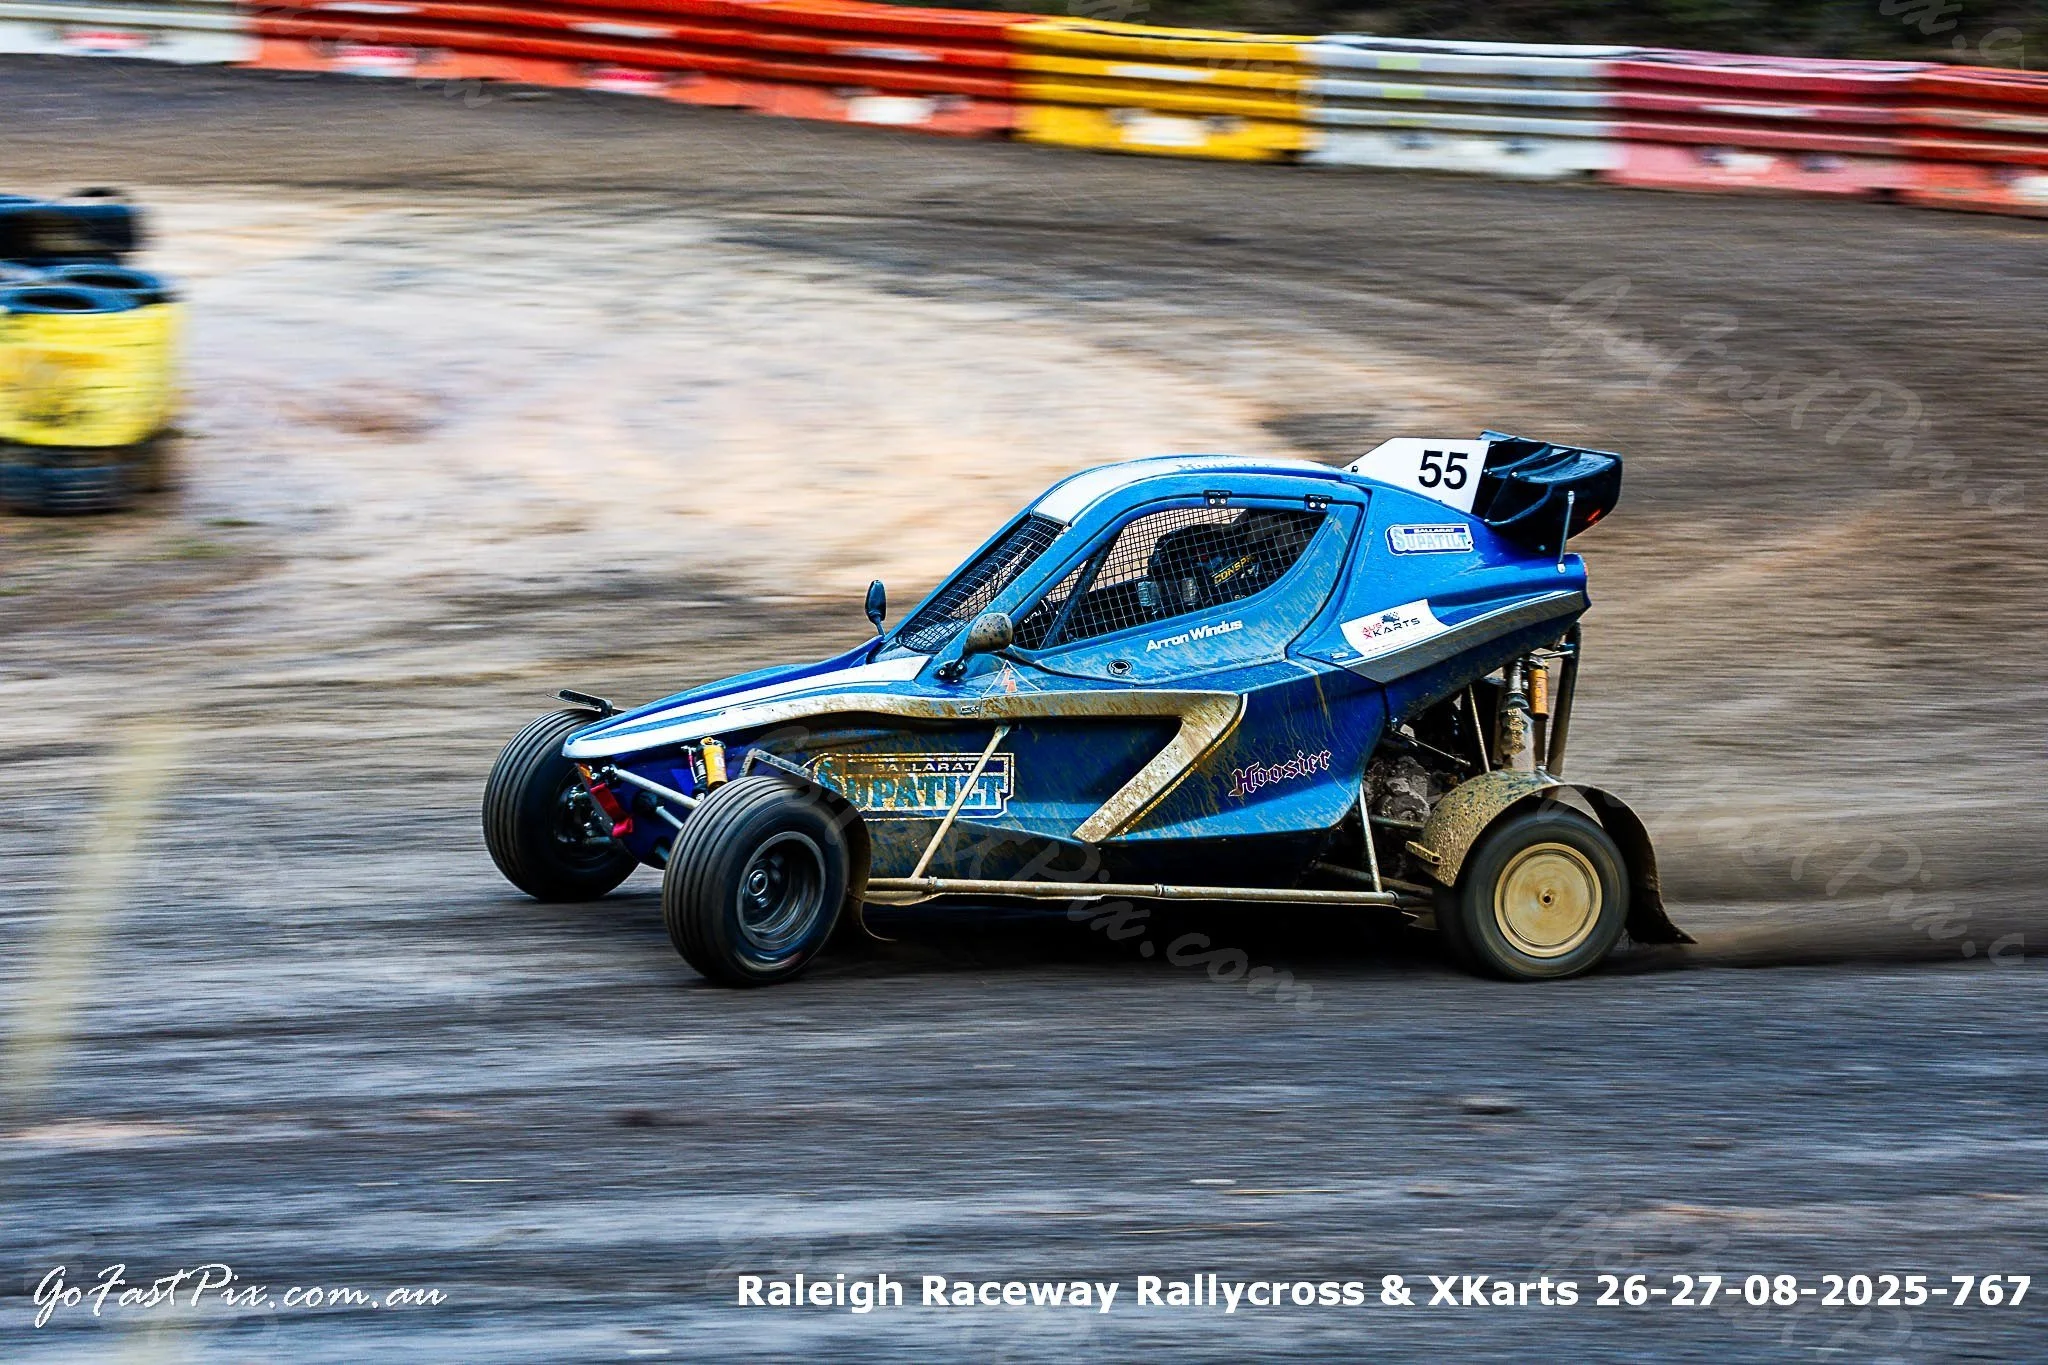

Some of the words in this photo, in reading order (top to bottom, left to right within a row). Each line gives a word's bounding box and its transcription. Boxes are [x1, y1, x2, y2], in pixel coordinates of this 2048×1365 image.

[1418, 449, 1469, 490] 55
[1392, 527, 1469, 551] SUPATILT
[1145, 632, 1190, 652] Arron
[1188, 619, 1244, 641] Windus
[814, 758, 1006, 811] SUPATILT
[872, 761, 980, 773] BALLARAT
[1228, 750, 1332, 797] Hoosier
